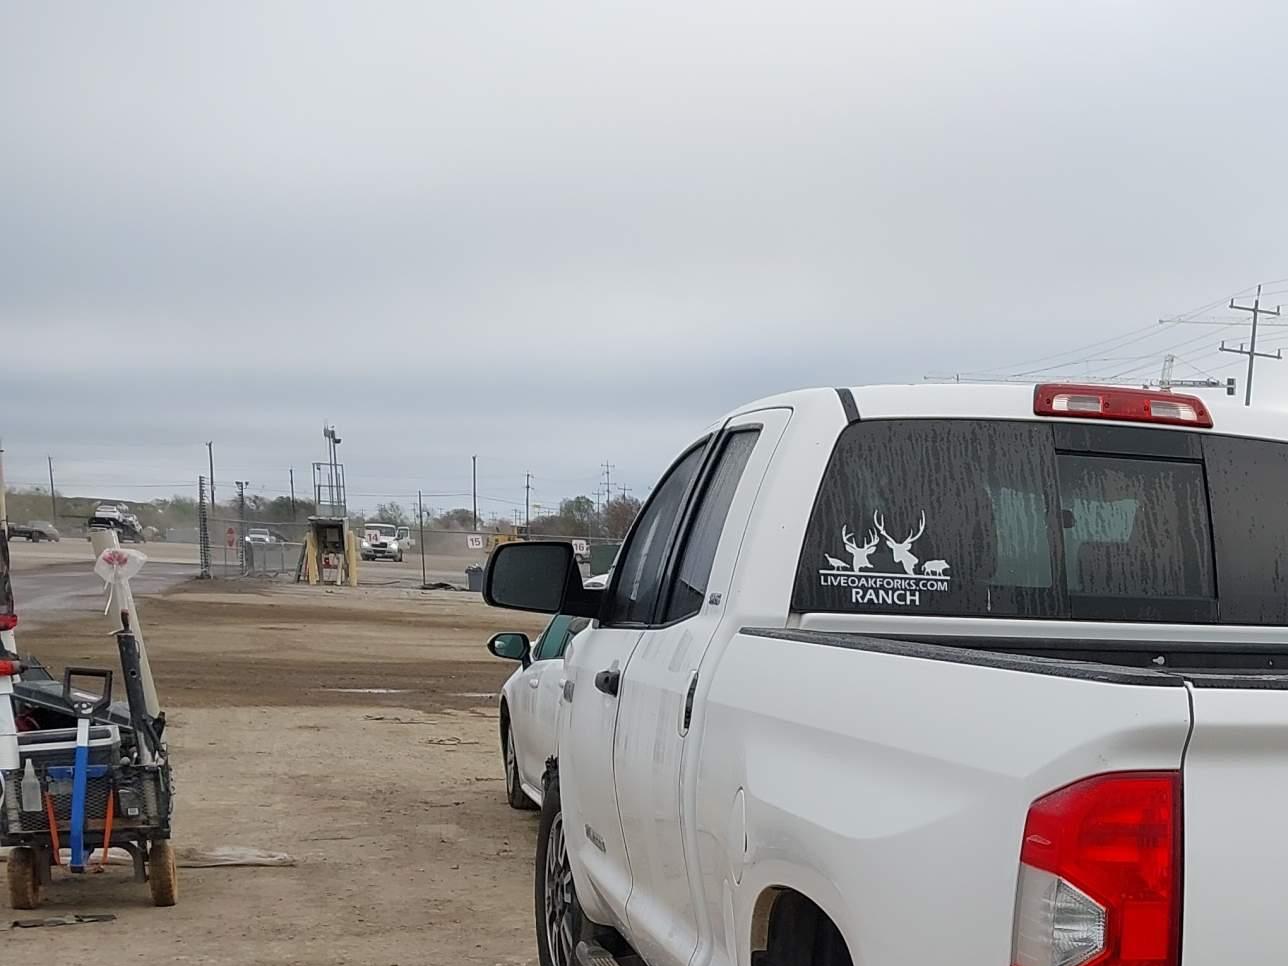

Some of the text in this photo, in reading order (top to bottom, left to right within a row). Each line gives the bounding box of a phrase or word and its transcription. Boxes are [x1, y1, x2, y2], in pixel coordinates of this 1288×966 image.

[469, 537, 481, 546] 15
[573, 543, 585, 551] 16
[820, 575, 948, 592] LIVEOAKFORKS.COM
[852, 588, 920, 606] RANCH
